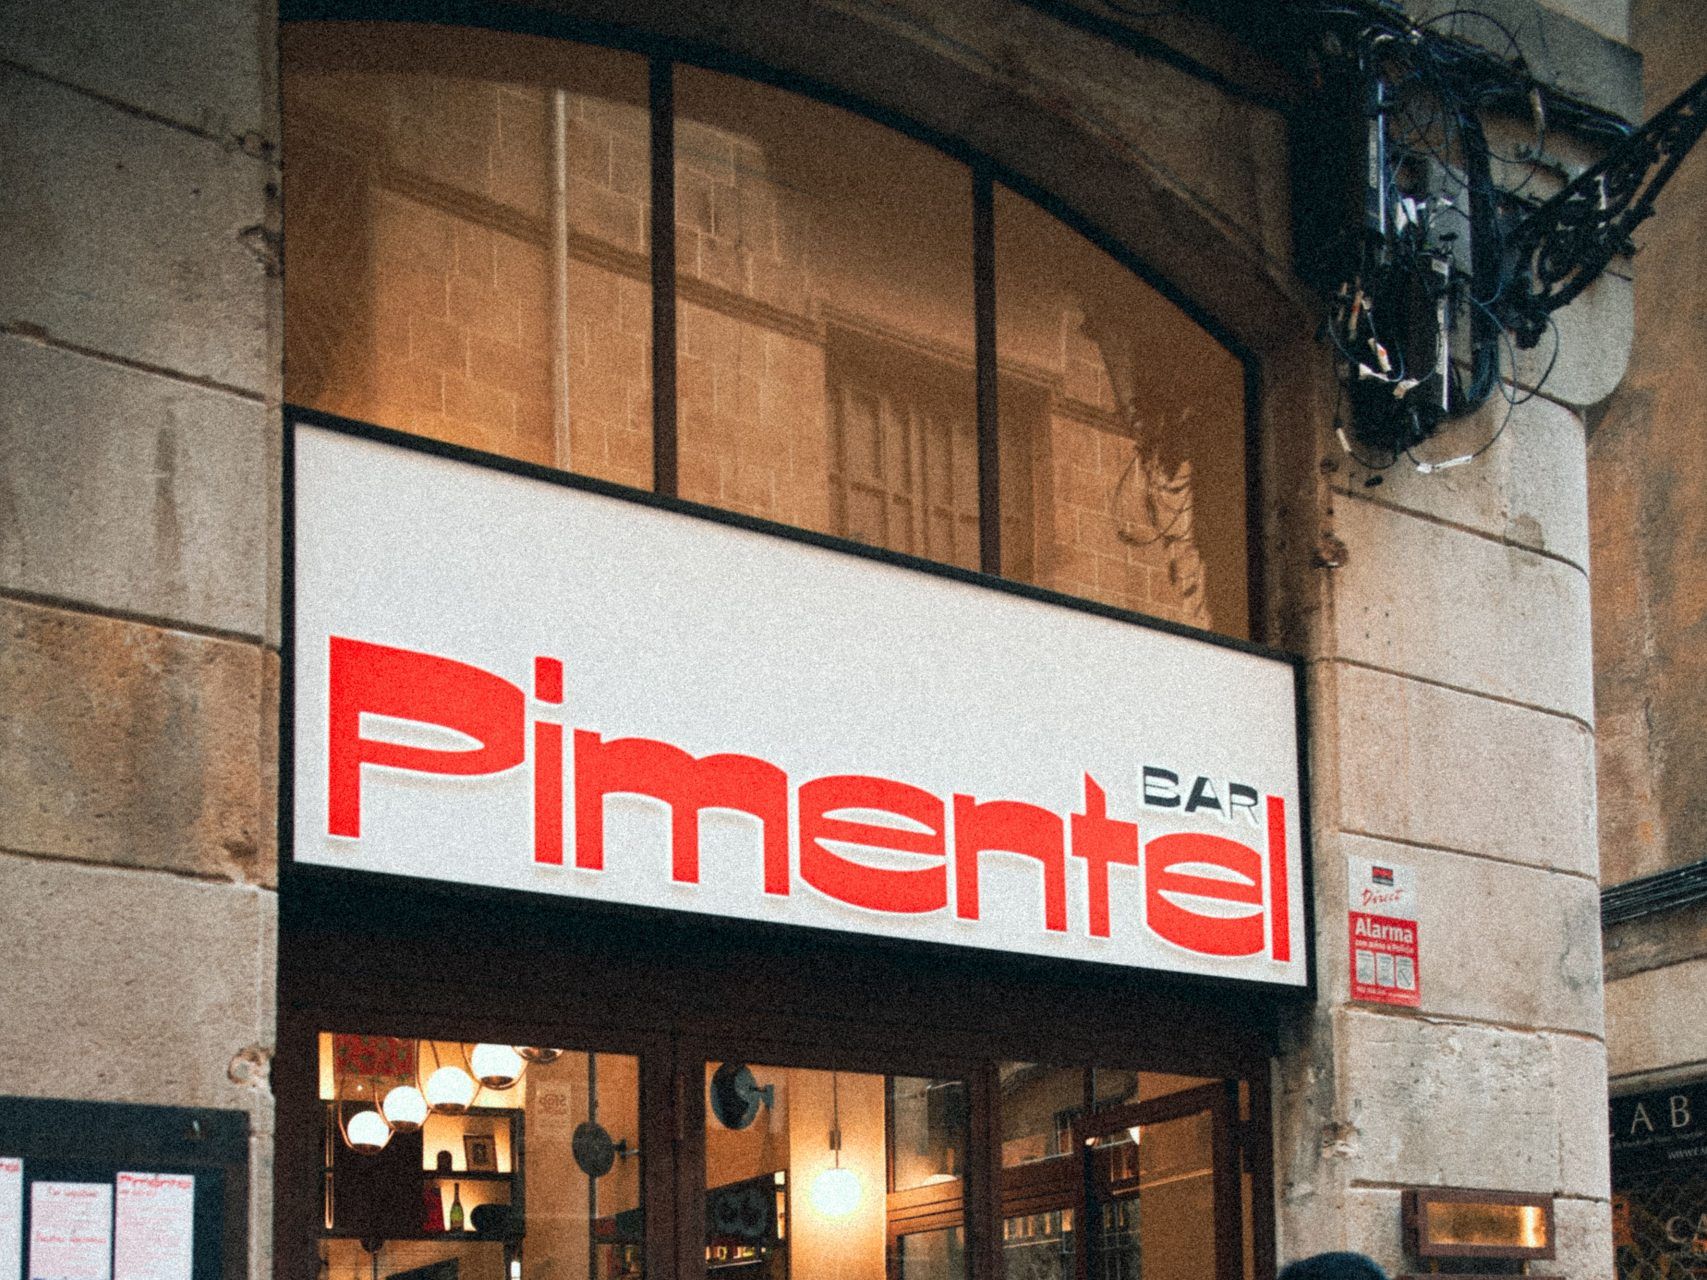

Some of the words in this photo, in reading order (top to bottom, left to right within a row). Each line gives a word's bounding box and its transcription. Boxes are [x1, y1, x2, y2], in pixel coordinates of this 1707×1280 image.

[329, 635, 1290, 962] Pimentel
[1142, 765, 1259, 824] BAR
[1355, 917, 1414, 944] Alarma
